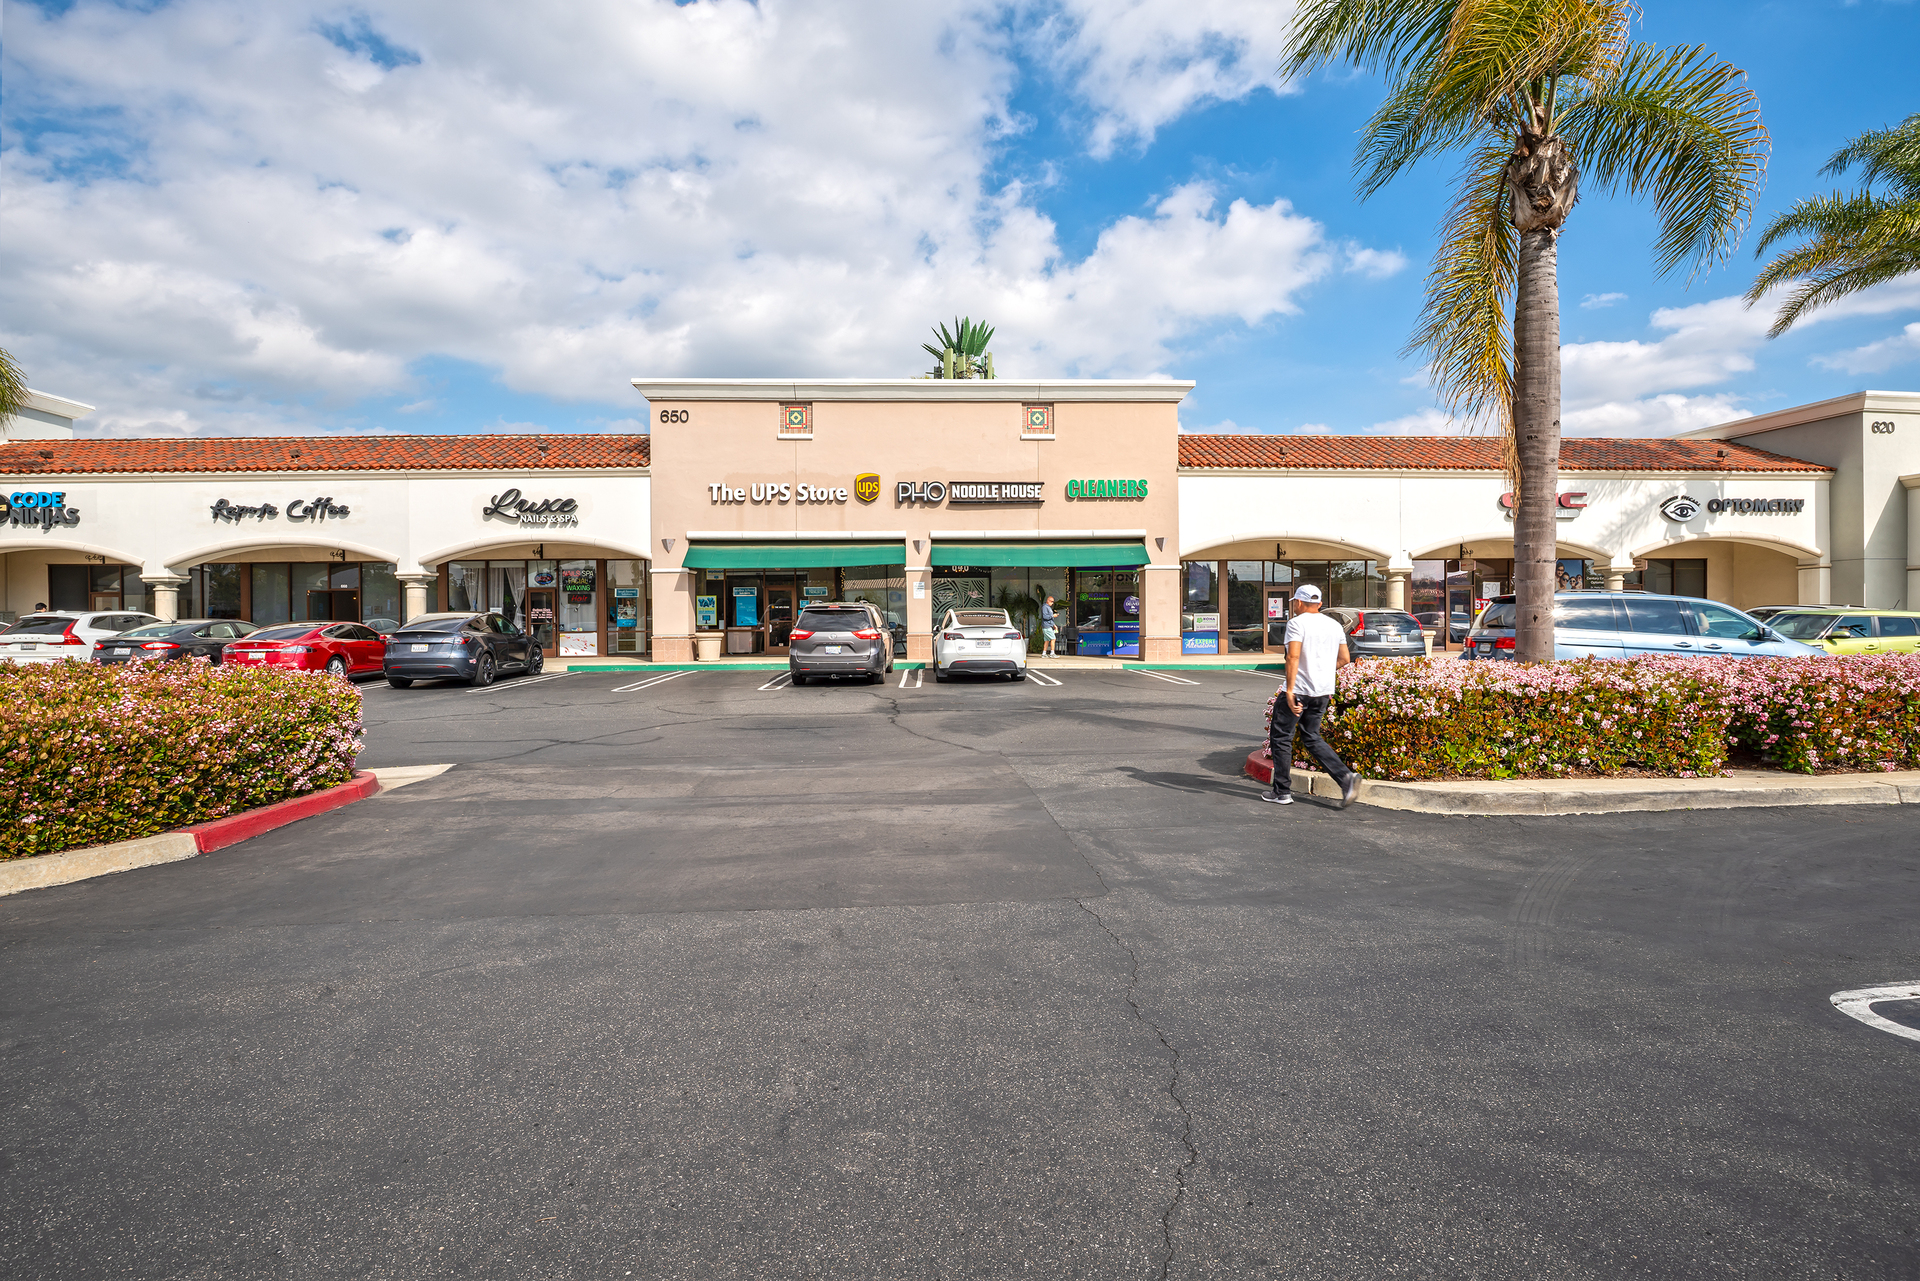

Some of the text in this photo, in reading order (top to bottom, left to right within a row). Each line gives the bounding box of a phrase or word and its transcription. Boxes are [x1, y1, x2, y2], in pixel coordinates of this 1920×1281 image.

[660, 409, 690, 424] 650
[1871, 420, 1896, 435] 620
[709, 482, 848, 502] The UPS Store
[858, 481, 879, 497] ups
[897, 480, 946, 503] PHO
[951, 484, 1042, 499] NOODLE HOUSE
[1067, 478, 1149, 498] CLEANERS
[9, 491, 66, 509] CODE
[482, 488, 578, 518] Luxe
[1707, 498, 1805, 513] OPTOMETRY
[210, 496, 350, 525] Repose Coffee
[9, 507, 80, 530] NINJAS
[520, 514, 578, 523] NAILS & SPA
[562, 569, 581, 577] NAILS
[566, 584, 591, 592] WAXING
[571, 594, 588, 602] Hair
